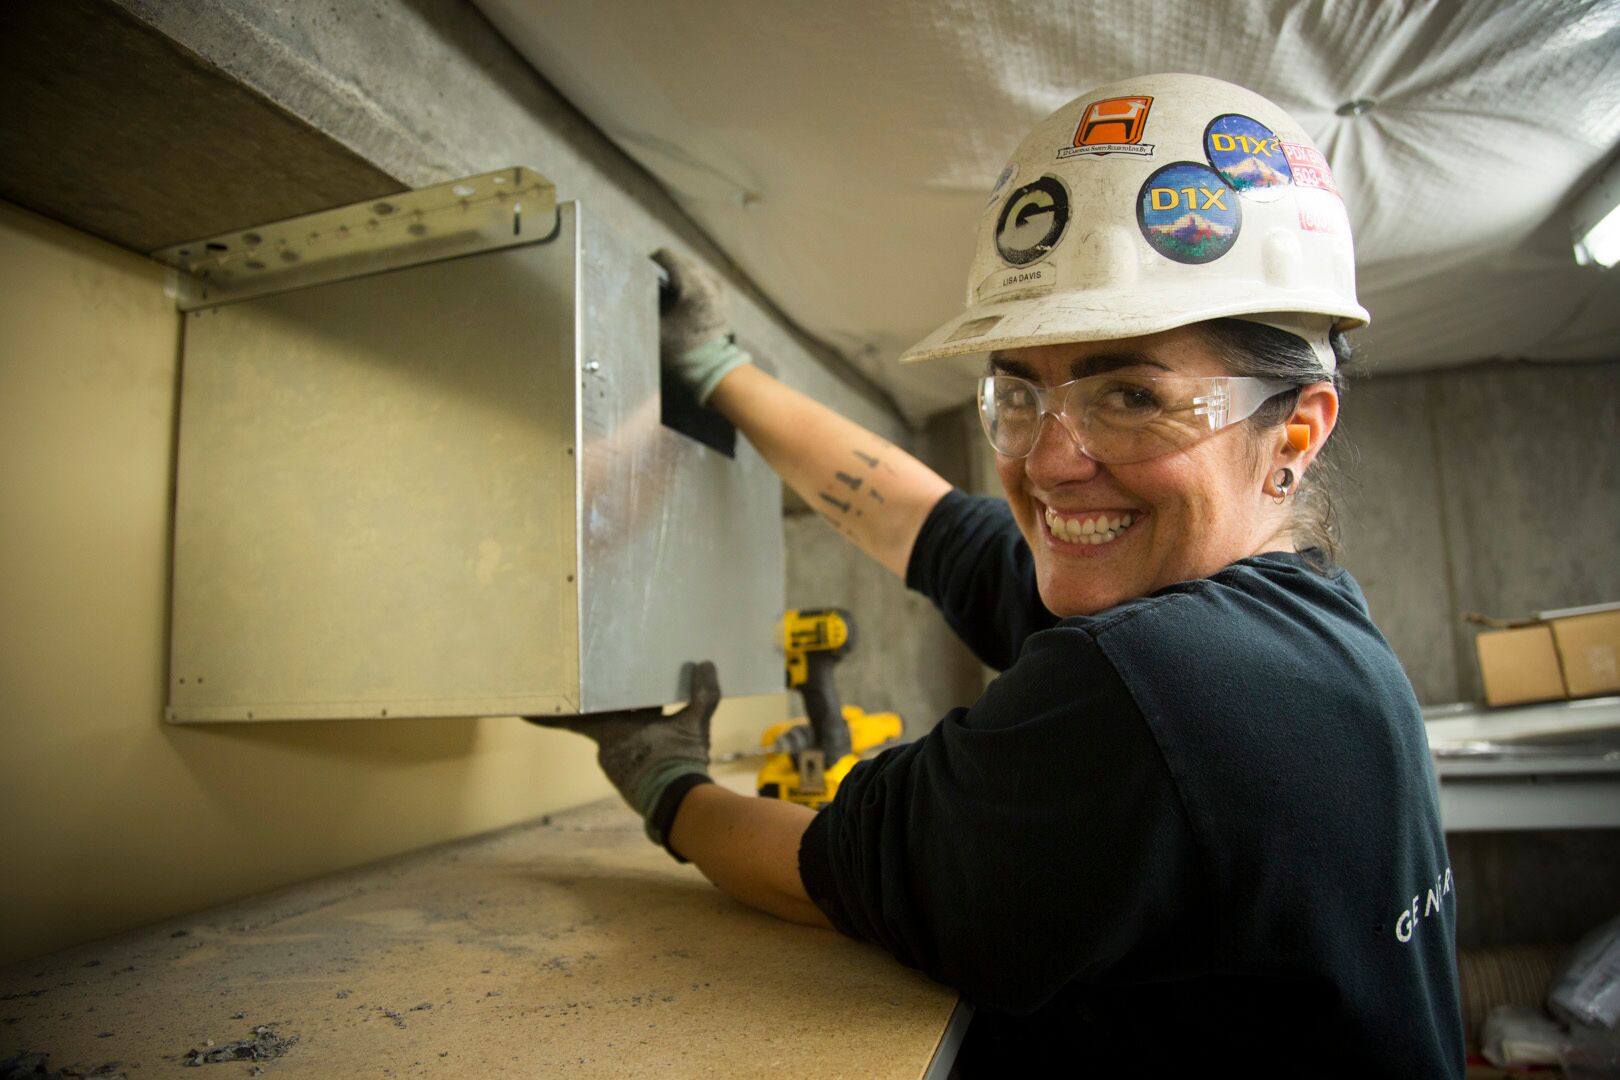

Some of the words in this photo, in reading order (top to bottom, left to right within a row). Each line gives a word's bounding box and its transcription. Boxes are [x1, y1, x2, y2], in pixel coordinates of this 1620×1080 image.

[1151, 187, 1229, 211] D1X
[1003, 275, 1018, 287] LISA
[1018, 271, 1042, 282] DAVIS
